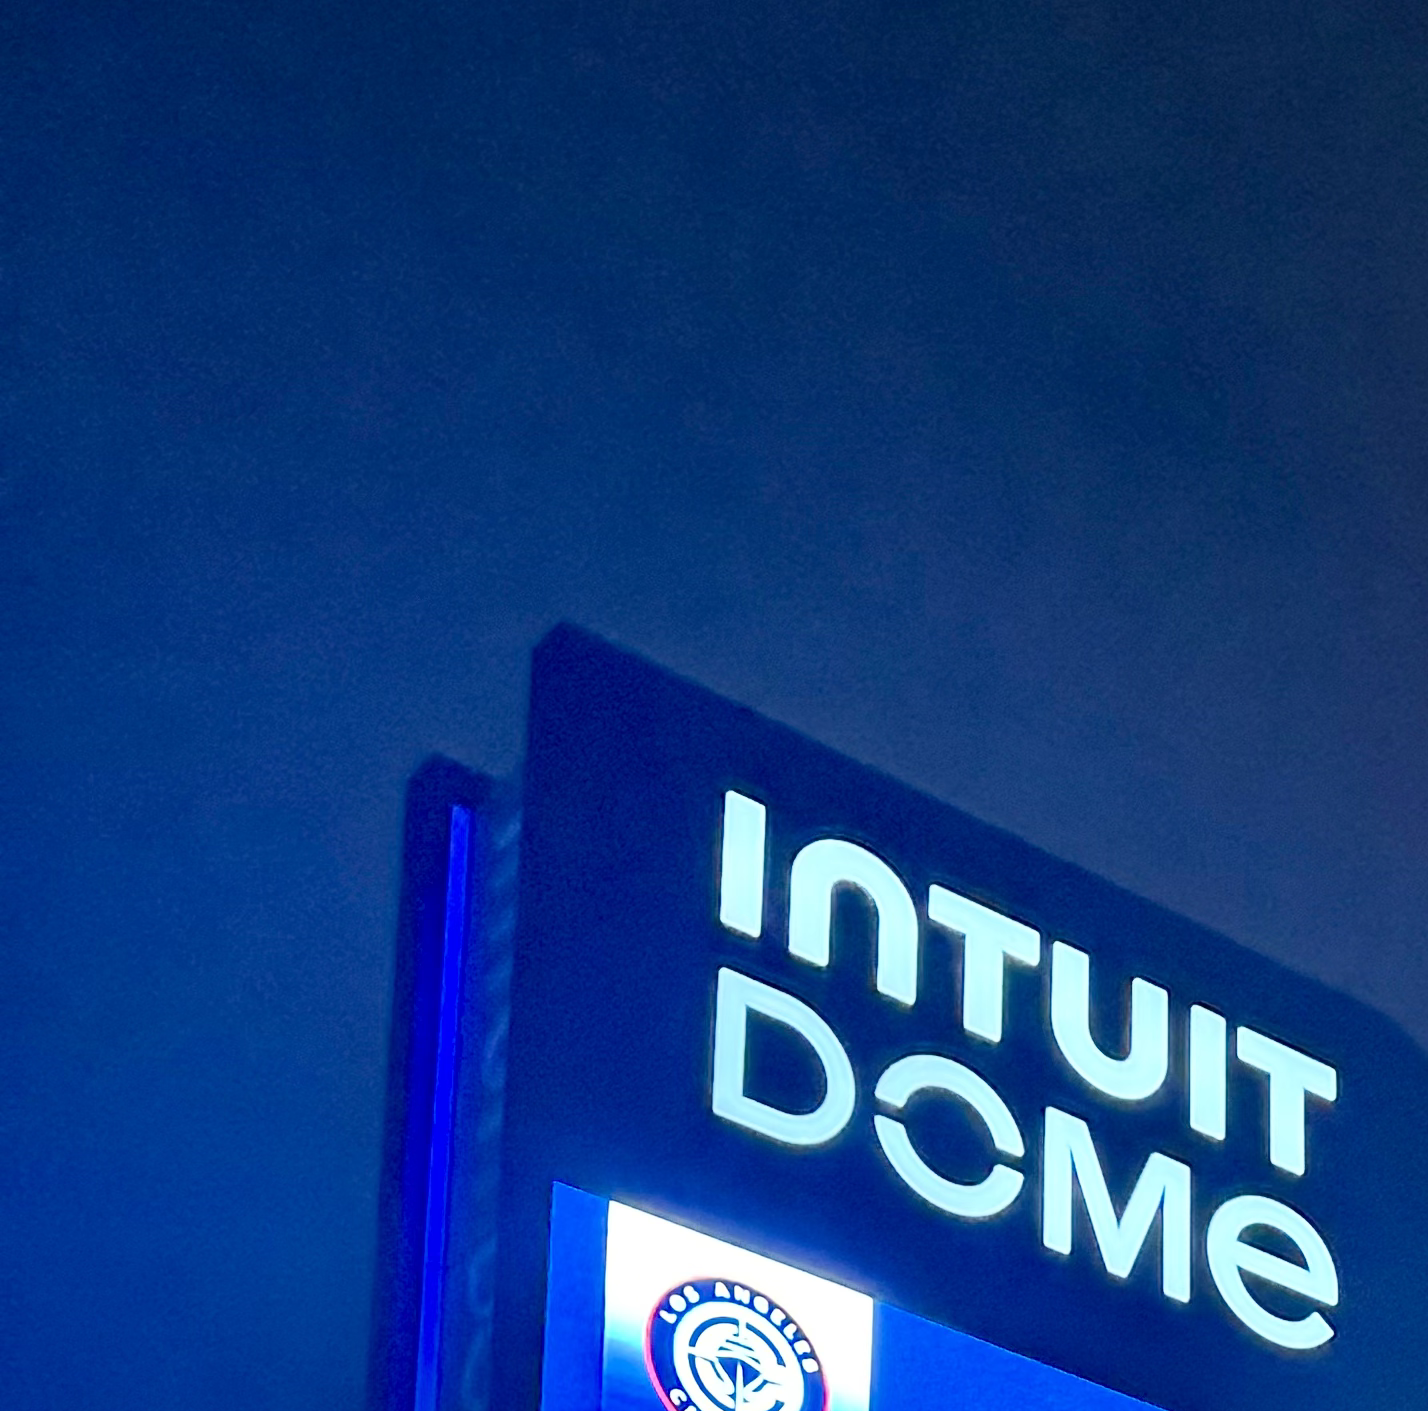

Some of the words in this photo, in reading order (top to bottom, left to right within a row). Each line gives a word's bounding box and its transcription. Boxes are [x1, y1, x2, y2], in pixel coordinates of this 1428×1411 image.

[711, 966, 1340, 1350] DOME
[718, 789, 1338, 1178] INTUIT
[658, 1284, 701, 1325] LOS
